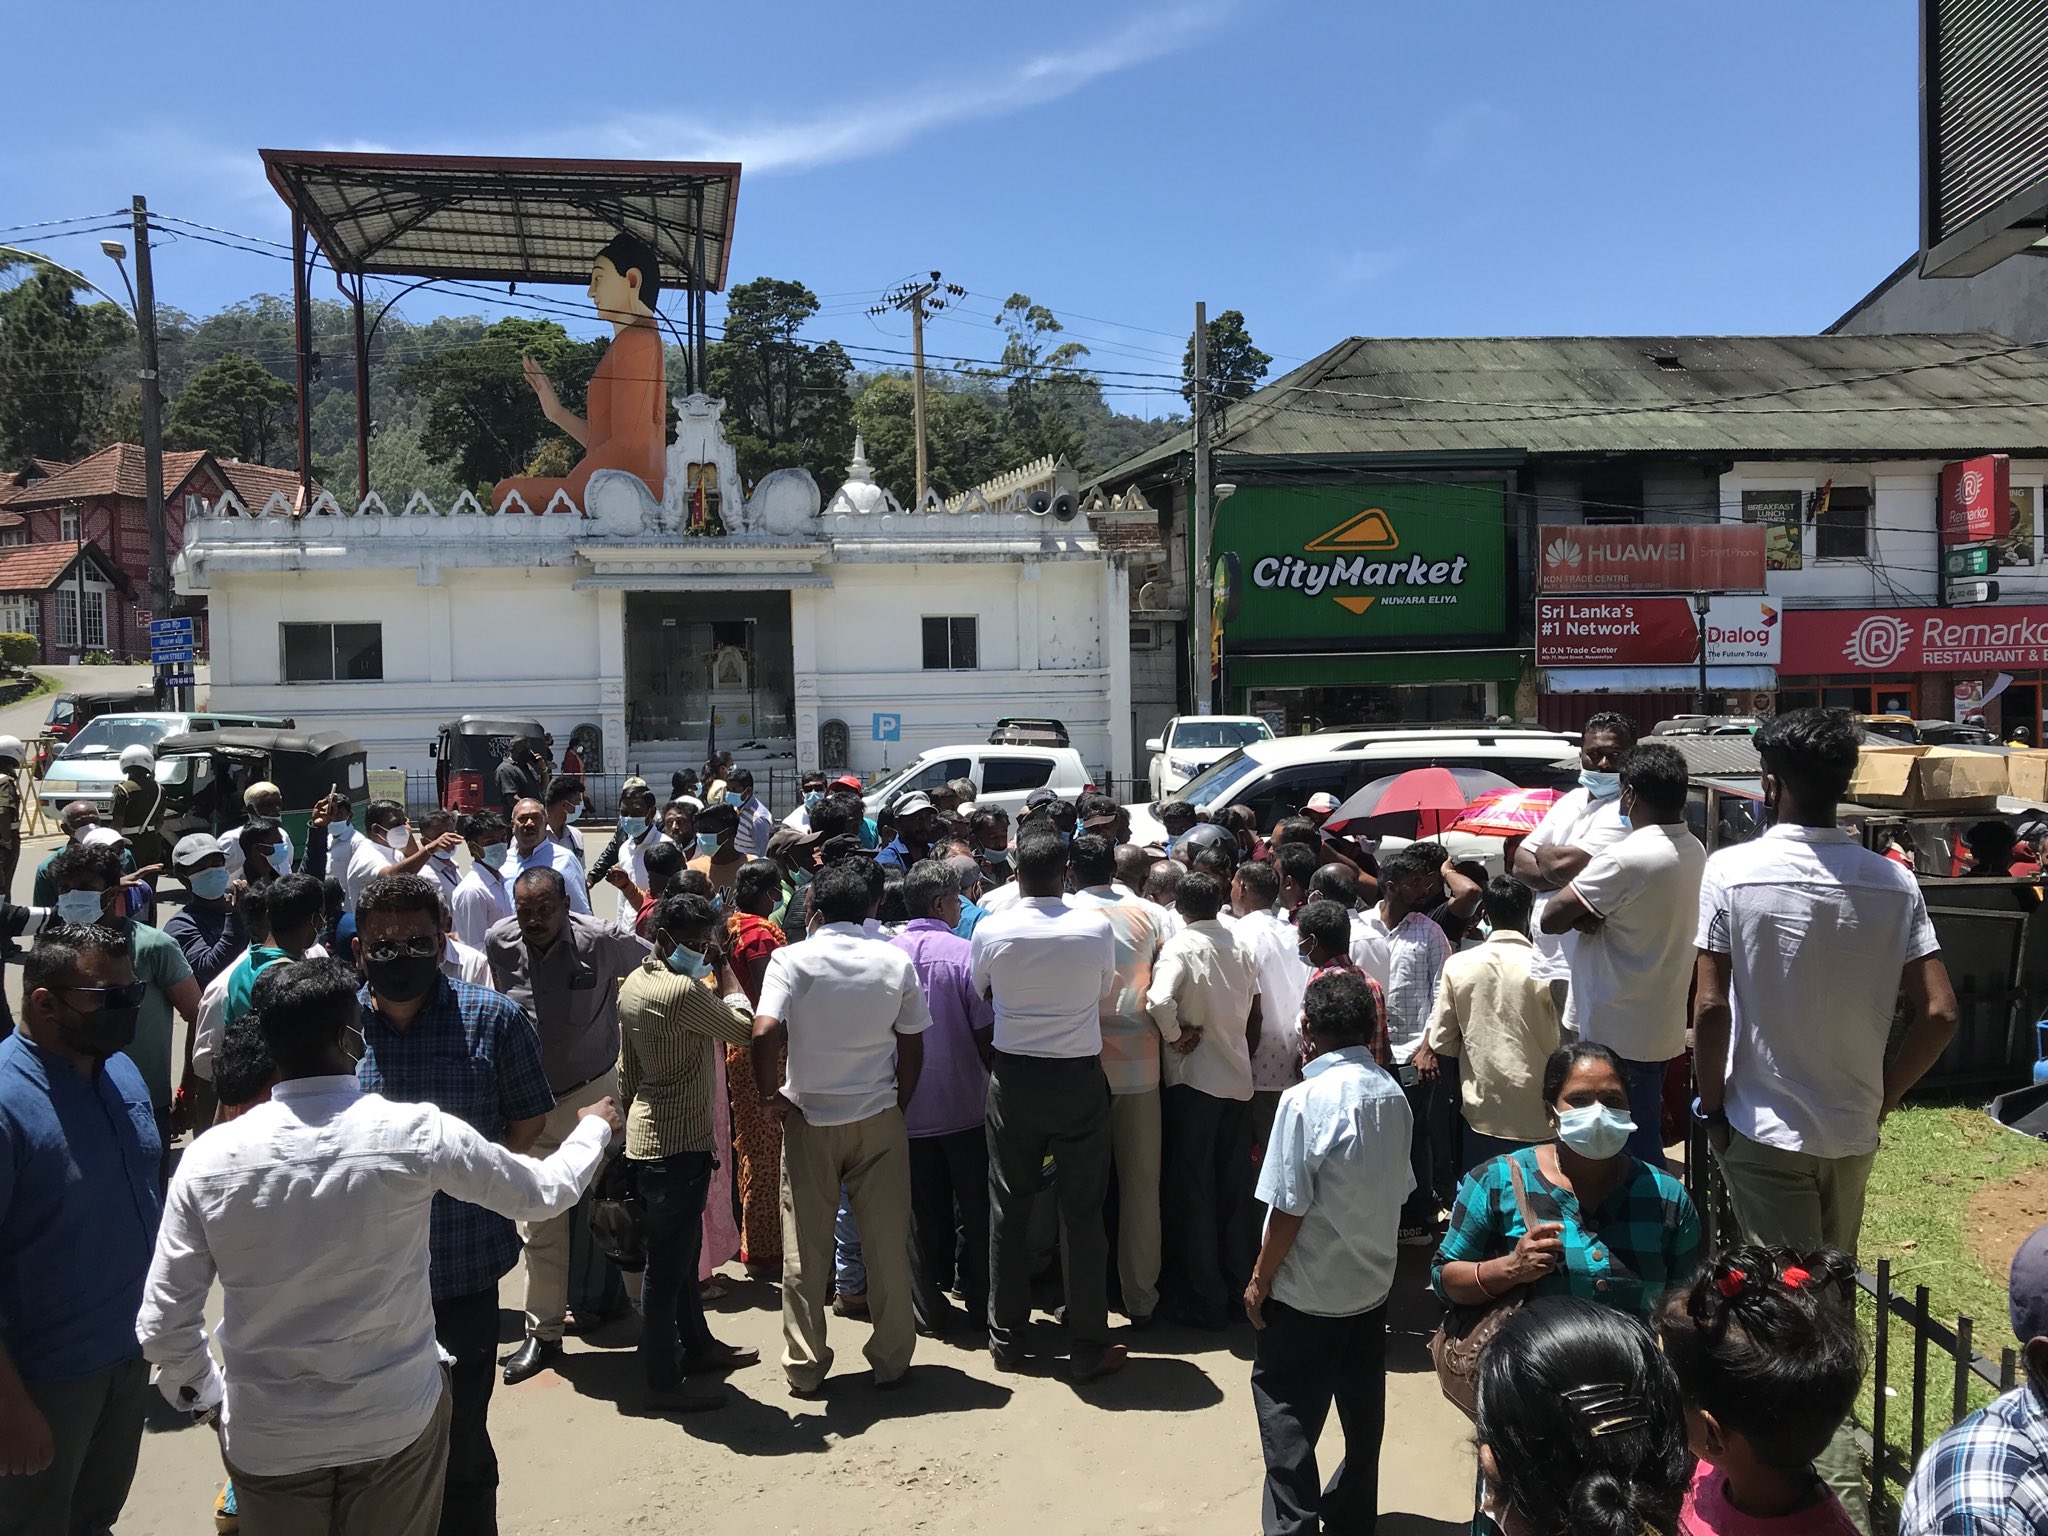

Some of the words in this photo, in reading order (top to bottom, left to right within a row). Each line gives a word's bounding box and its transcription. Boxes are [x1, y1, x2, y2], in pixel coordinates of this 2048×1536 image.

[1747, 503, 1796, 511] BREAKFAST
[1949, 506, 1989, 523] Remarko
[1588, 543, 1685, 561] HUAWEI
[1253, 555, 1467, 596] CityMarket
[1543, 575, 1561, 583] KDN
[1564, 574, 1593, 583] TRADE
[1594, 574, 1630, 582] CENTRE
[1380, 596, 1426, 606] NUWARA
[1428, 595, 1458, 605] ELIYA
[1541, 605, 1565, 619] Sri
[1569, 604, 1634, 619] Lanka's
[1541, 622, 1560, 636] #1
[1566, 621, 1641, 635] Network
[1922, 617, 2048, 646] Remarko
[1707, 626, 1770, 647] Dialog
[159, 653, 170, 661] MAIN
[170, 652, 186, 660] STREET
[1565, 646, 1589, 654] Trade
[1590, 646, 1618, 654] Center
[1747, 651, 1769, 659] Today.
[1922, 649, 2026, 665] RESTAURANT
[2028, 649, 2040, 662] &
[878, 716, 897, 738] P
